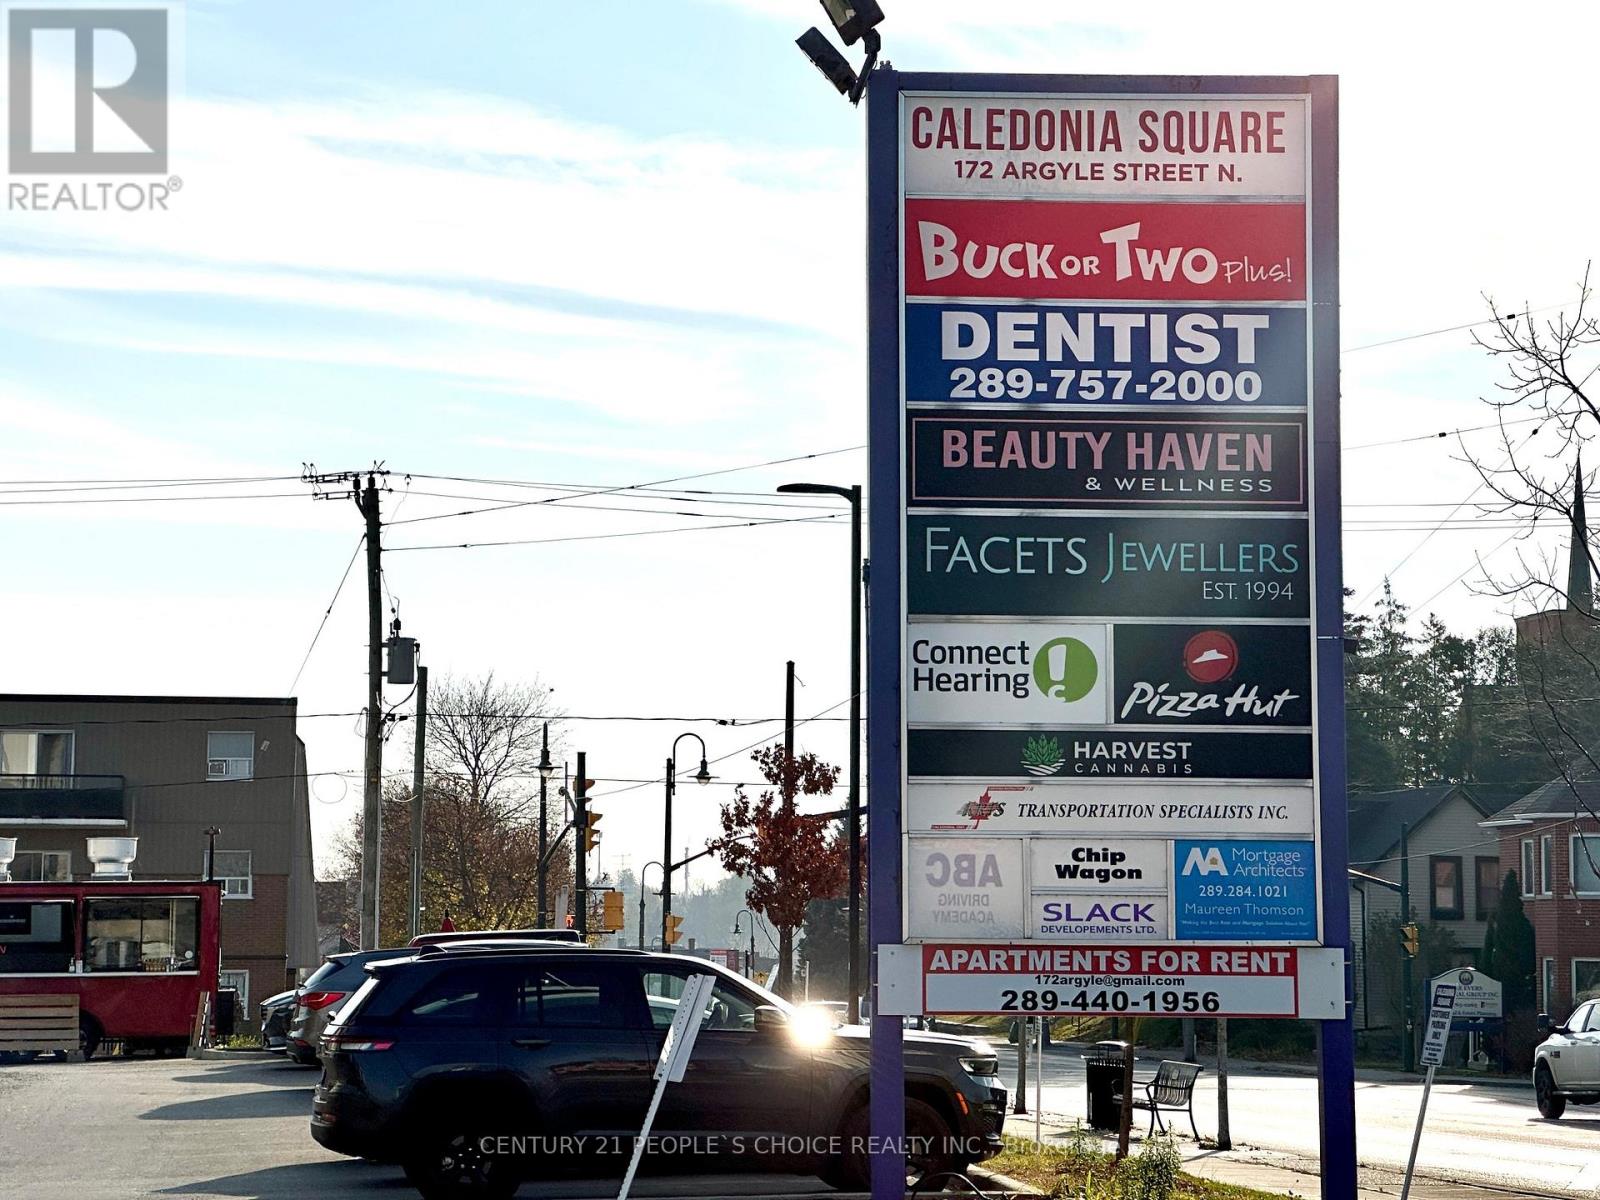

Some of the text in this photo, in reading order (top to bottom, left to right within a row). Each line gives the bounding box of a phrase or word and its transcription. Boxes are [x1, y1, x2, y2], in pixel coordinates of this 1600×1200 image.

[912, 106, 1287, 155] CALEDONIA SQUARE
[954, 160, 1243, 183] 172 ARGYLE STREET N.
[1223, 257, 1293, 284] Plus!
[941, 311, 1270, 364] DENTIST
[949, 367, 1263, 401] 289-757-2000
[942, 429, 1273, 472] BEAUTY HAVEN
[1085, 476, 1273, 493] & WELLNESS
[1202, 582, 1294, 601] EST. 1994
[912, 639, 1030, 665] Connect
[913, 667, 1030, 699] Hearing
[1120, 681, 1301, 719] Pizza Hut
[1074, 741, 1193, 760] HARVEST
[1074, 763, 1193, 774] CANNABIS
[1018, 802, 1156, 819] TRANSPORTATION
[1158, 803, 1254, 820] SPECIALISTS
[1257, 805, 1289, 820] INC.
[1071, 847, 1126, 865] Chip
[1232, 847, 1301, 866] Mortgage
[1054, 864, 1143, 883] Wagon
[1233, 863, 1305, 877] Architects
[1198, 885, 1288, 898] 289.284.1021
[1042, 902, 1156, 923] SLACK
[1185, 903, 1304, 916] Maureen Thomson
[1041, 925, 1157, 934] DEVELOPEMENTS LTD.
[929, 950, 1291, 973] APARTMENTS FOR RENT
[1034, 974, 1186, 988] 172argyle@gmail.com
[1000, 989, 1220, 1012] 289-440-1956
